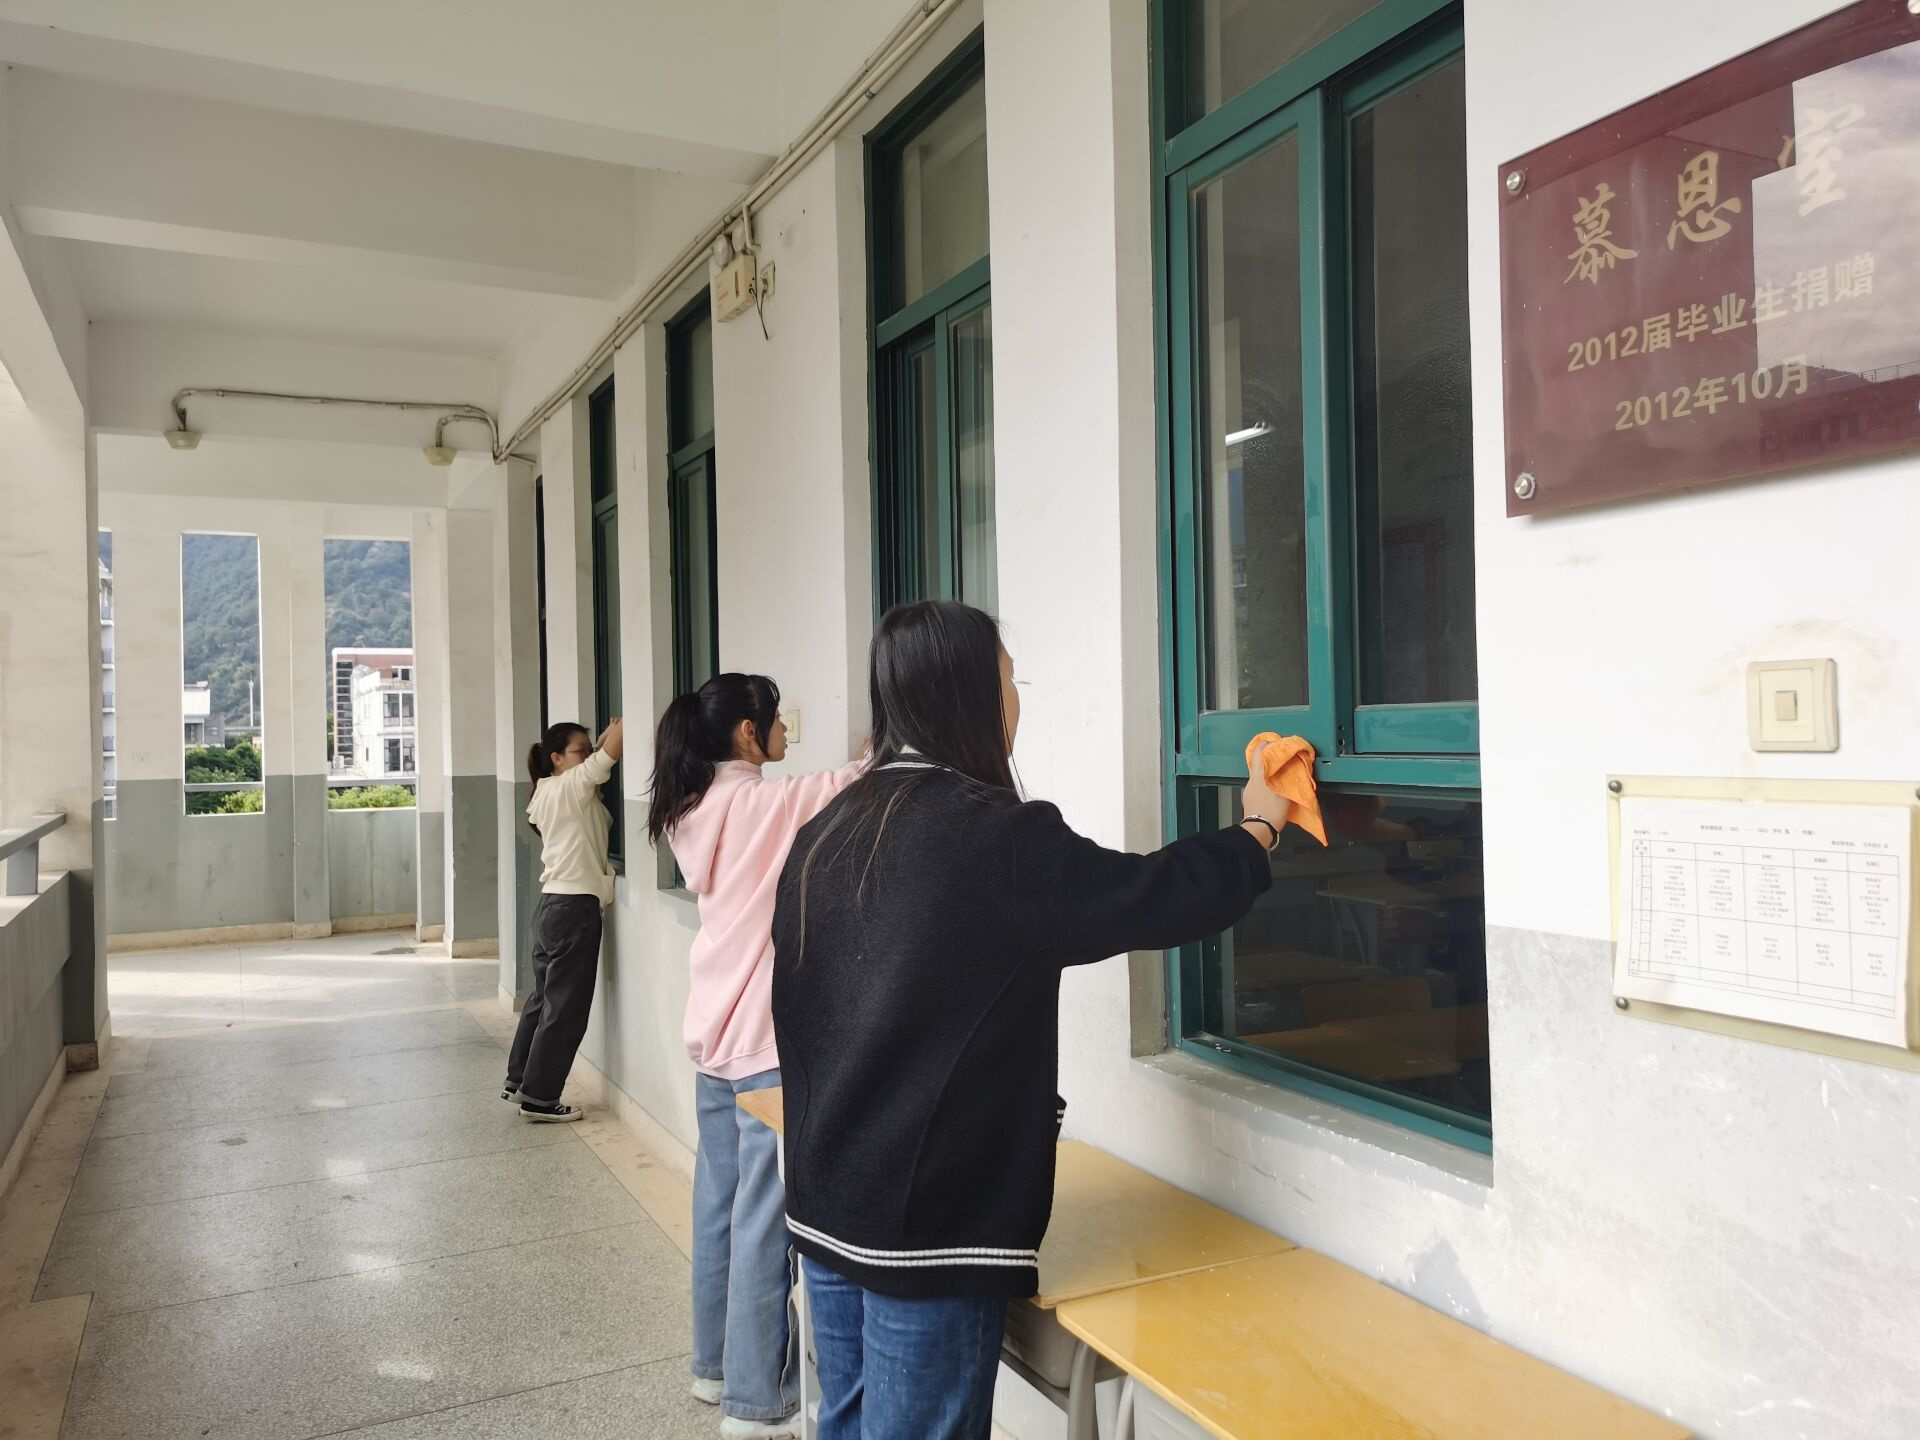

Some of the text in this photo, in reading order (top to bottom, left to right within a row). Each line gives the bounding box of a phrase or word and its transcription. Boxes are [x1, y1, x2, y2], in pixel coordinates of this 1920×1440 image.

[1567, 251, 1876, 373] 2012届毕业生捐赠
[1615, 353, 1809, 431] 2012年10月
